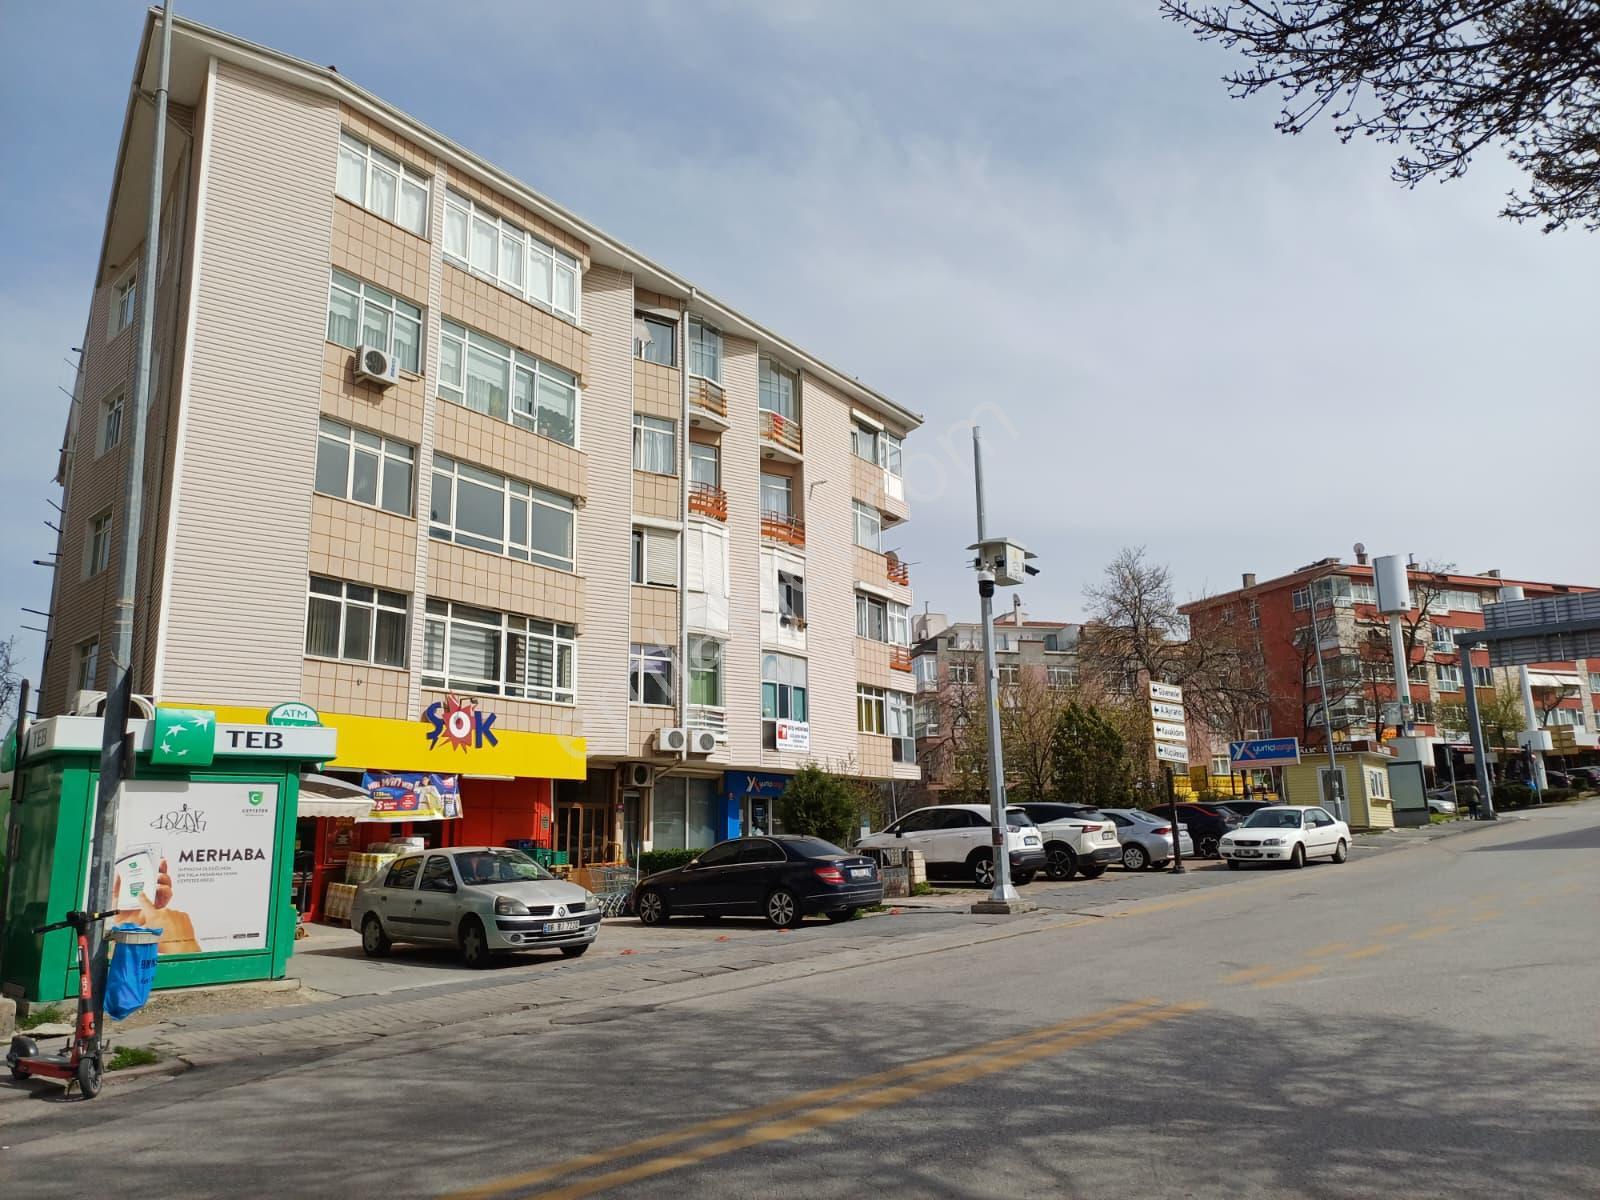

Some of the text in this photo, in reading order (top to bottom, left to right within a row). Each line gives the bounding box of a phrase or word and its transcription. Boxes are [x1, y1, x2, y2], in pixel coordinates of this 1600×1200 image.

[281, 708, 309, 719] ATM
[426, 702, 498, 751] ŞOK
[32, 727, 48, 748] TEB
[226, 730, 284, 750] TEB
[178, 848, 266, 863] MERHABA
